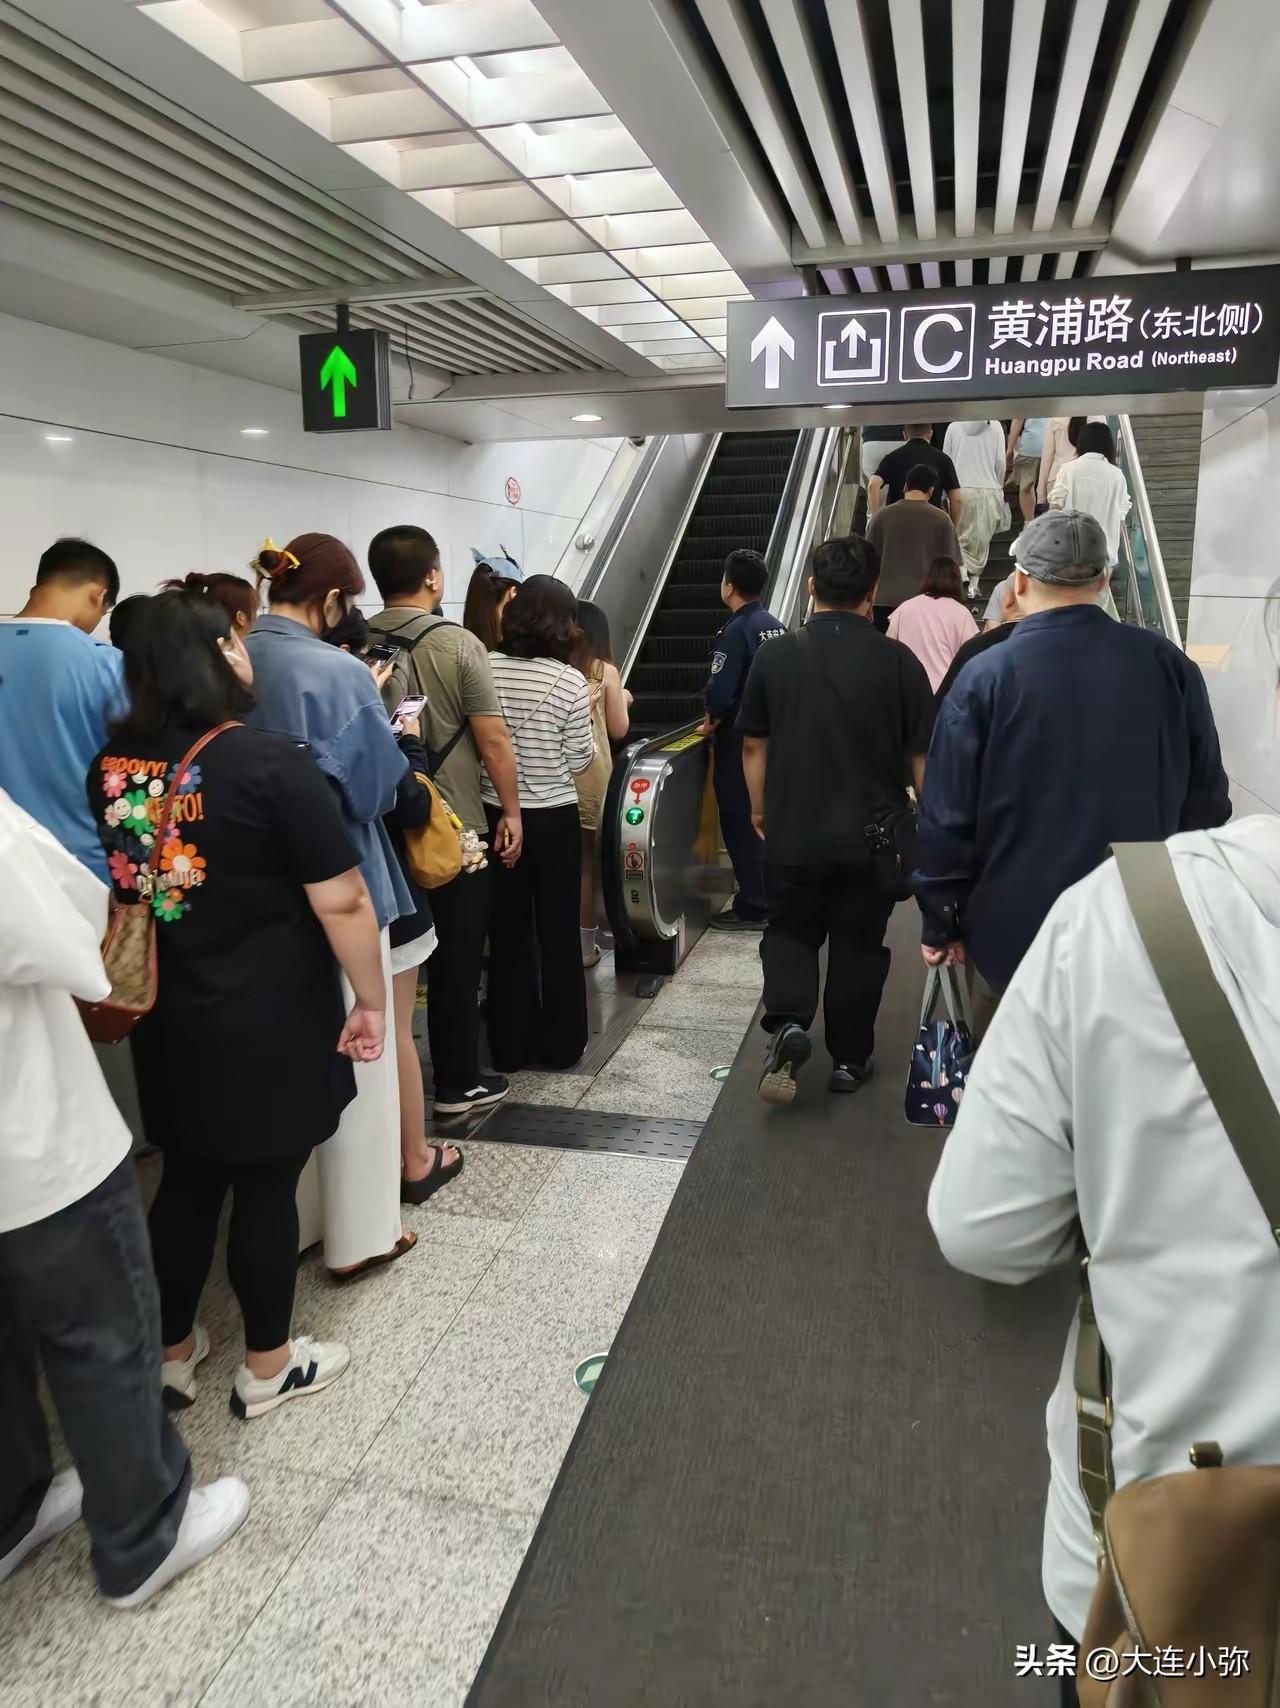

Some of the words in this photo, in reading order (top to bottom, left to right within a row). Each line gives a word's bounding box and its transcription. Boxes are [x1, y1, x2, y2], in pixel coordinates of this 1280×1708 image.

[913, 312, 964, 374] C
[985, 357, 1081, 377] Huangpu
[1086, 350, 1144, 371] Road
[1151, 346, 1237, 368] (Northeast)
